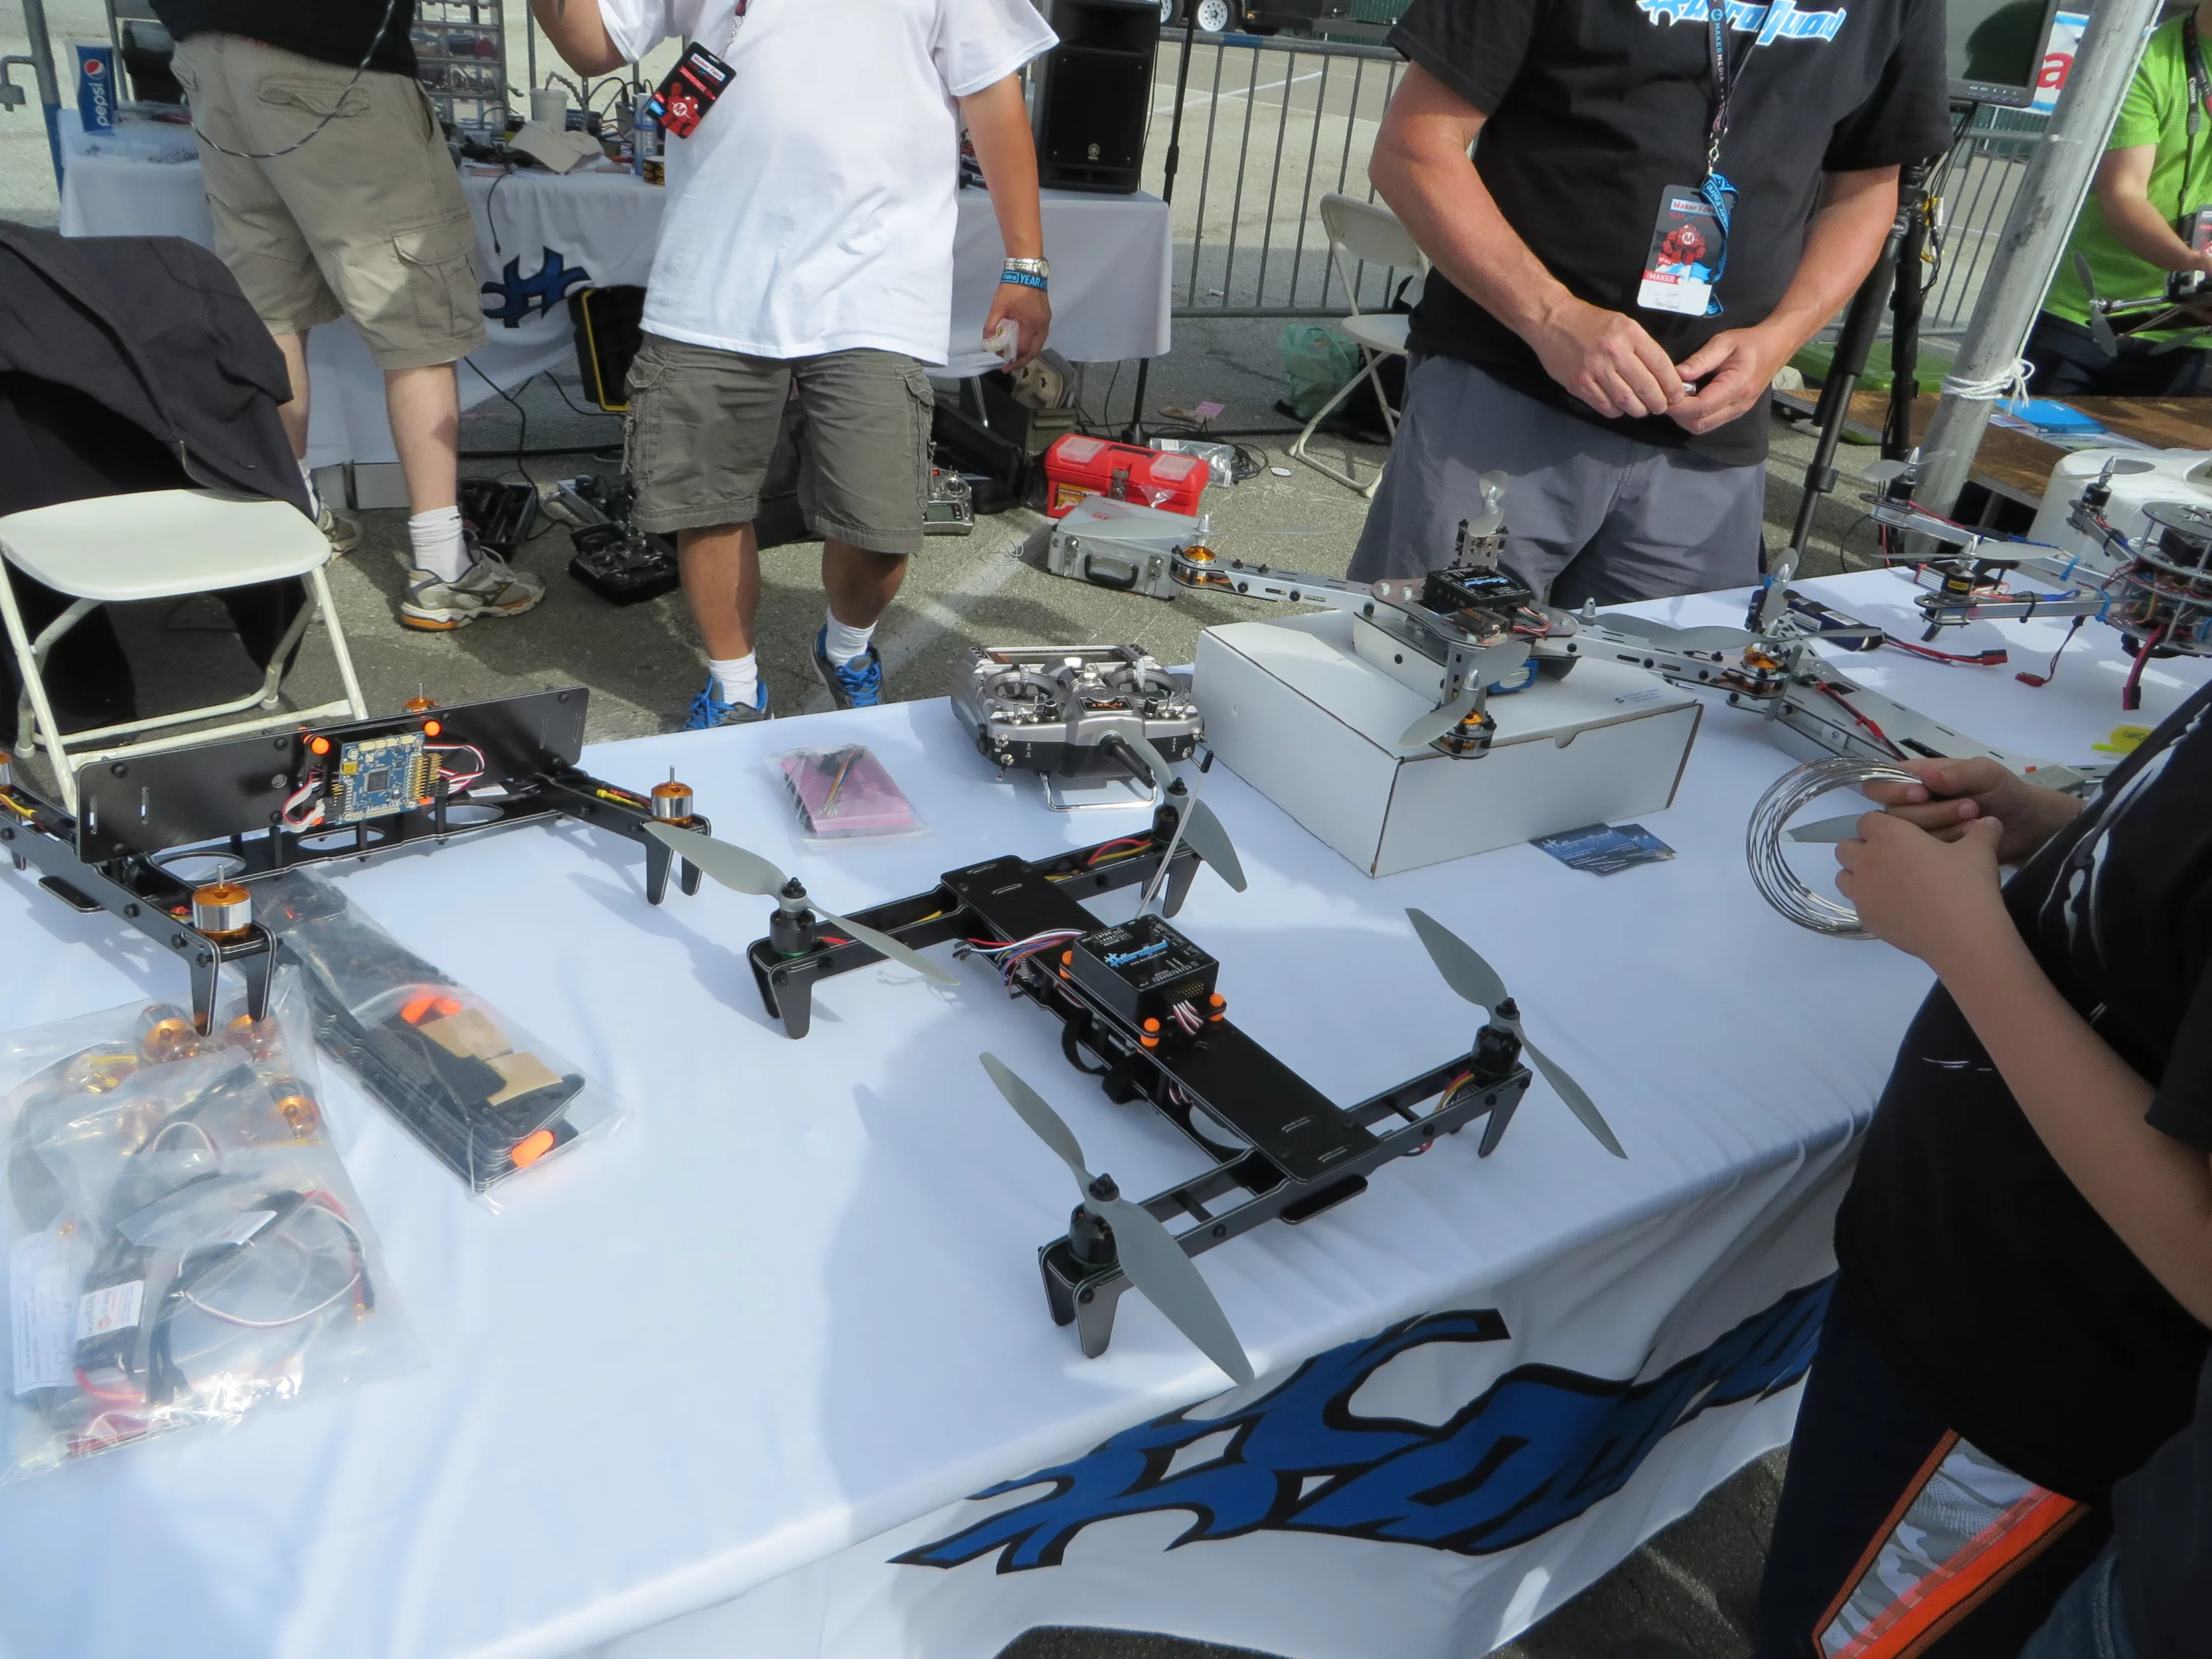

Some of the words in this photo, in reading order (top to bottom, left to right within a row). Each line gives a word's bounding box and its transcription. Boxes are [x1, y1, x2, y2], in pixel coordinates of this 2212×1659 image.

[88, 81, 111, 127] pepsi
[1672, 200, 1697, 212] Maker
[1020, 273, 1041, 287] YEAR
[1649, 272, 1676, 284] MAKER
